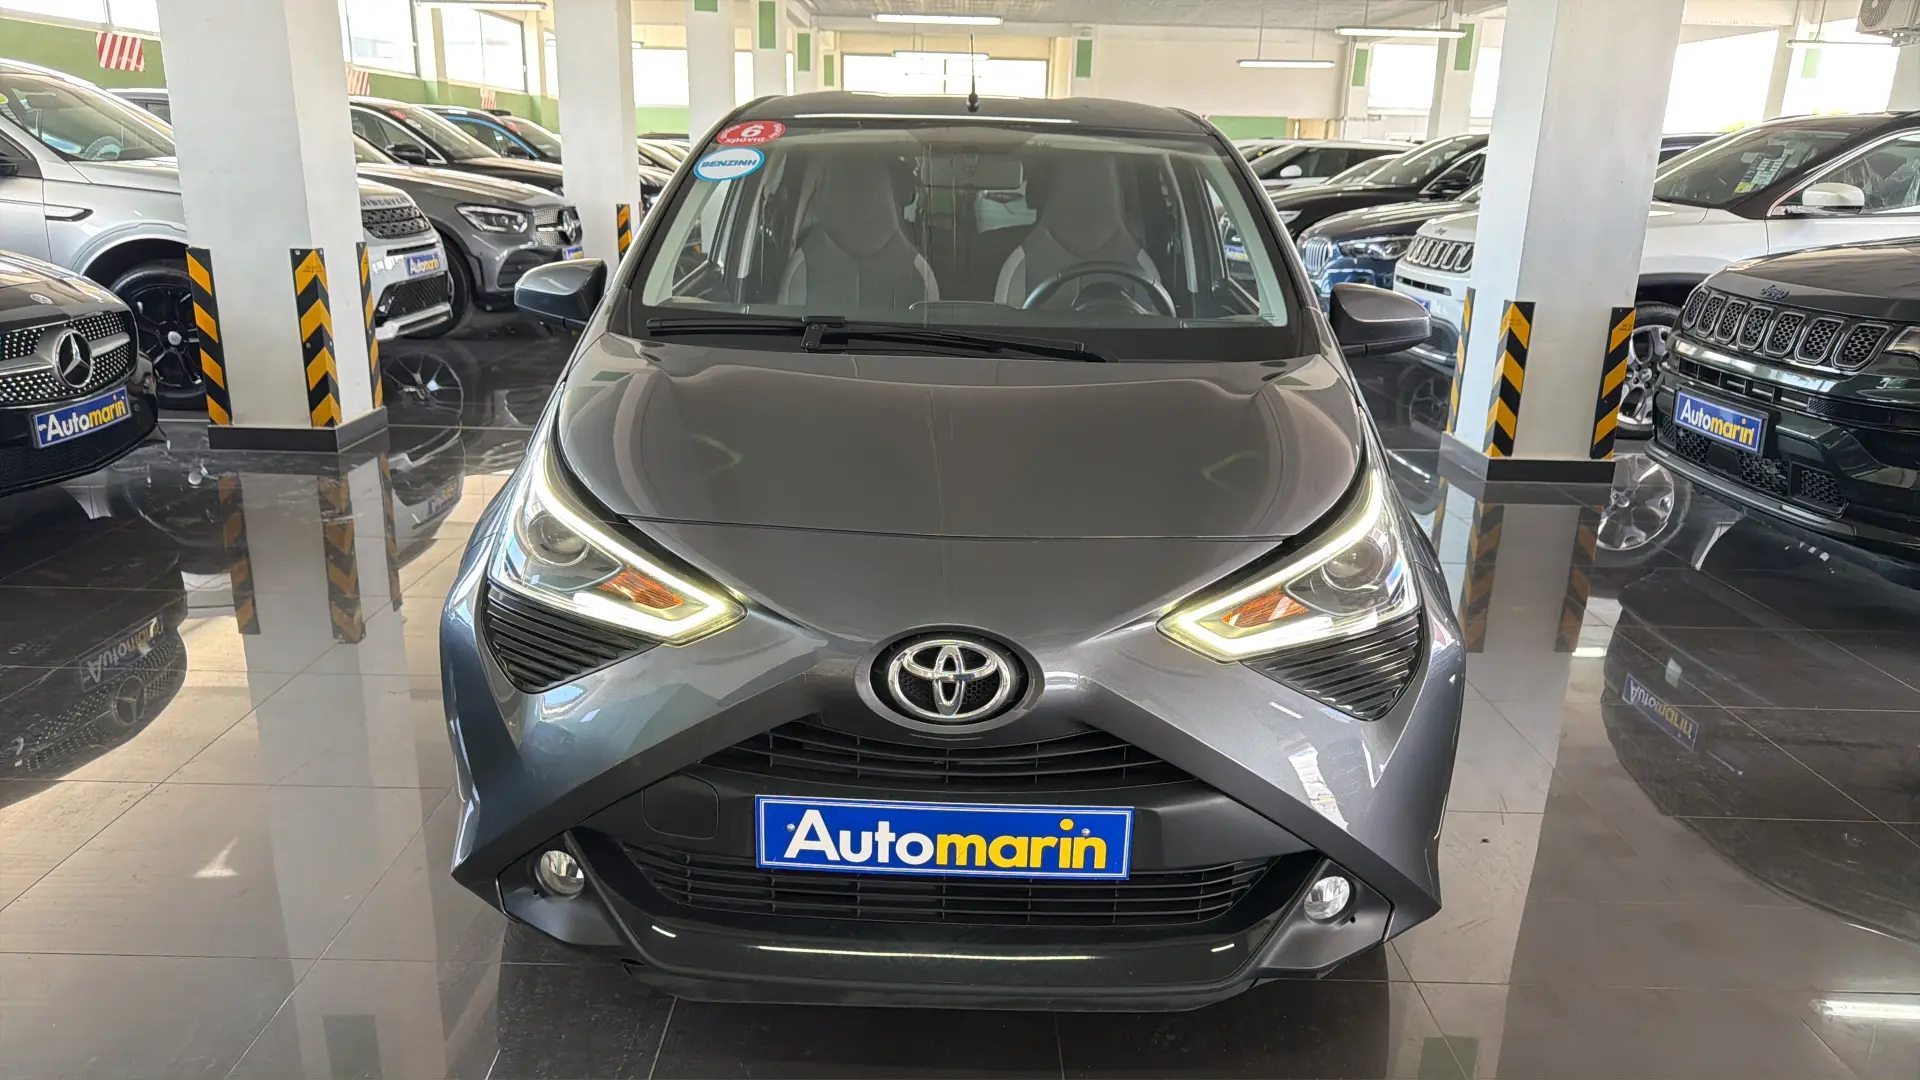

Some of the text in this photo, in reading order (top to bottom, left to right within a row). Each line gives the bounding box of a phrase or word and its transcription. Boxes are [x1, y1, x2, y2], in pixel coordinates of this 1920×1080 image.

[740, 124, 764, 138] 6
[47, 394, 126, 441] Automarin
[1680, 399, 1754, 446] Automarin
[784, 809, 1107, 869] Automarin
